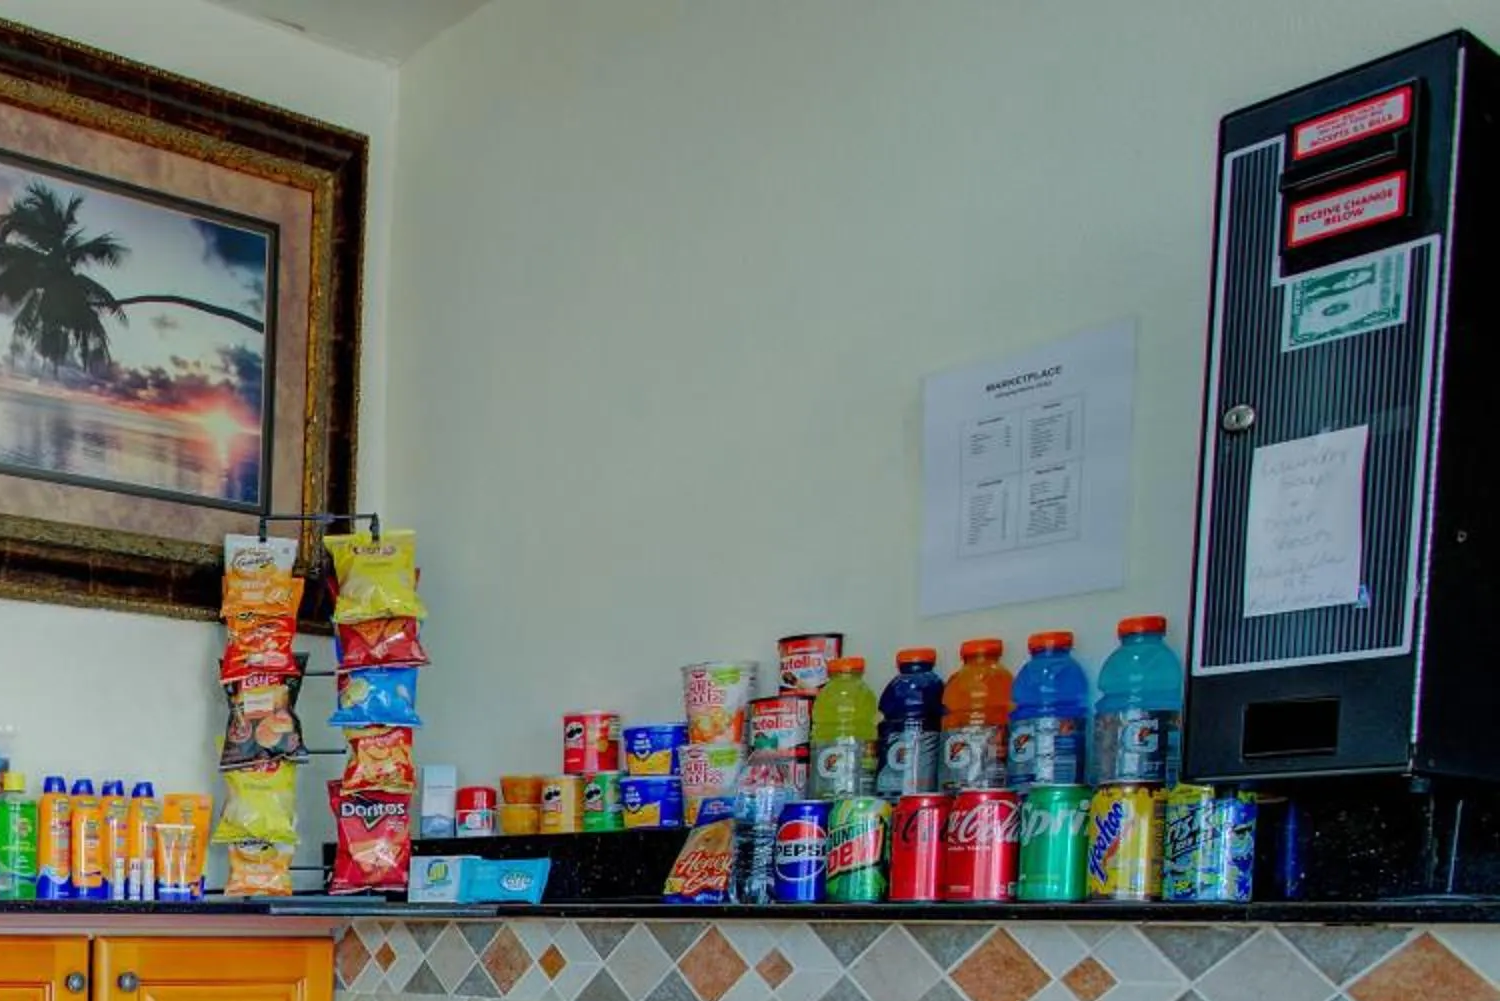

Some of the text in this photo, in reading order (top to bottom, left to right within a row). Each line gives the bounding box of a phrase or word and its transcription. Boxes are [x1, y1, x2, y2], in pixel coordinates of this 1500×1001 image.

[1298, 188, 1393, 224] RECEIVE CHANGE
[1324, 207, 1364, 226] BELOW
[985, 365, 1062, 392] MARKETPLACE
[341, 802, 405, 817] Doritos
[1020, 799, 1090, 846] Spri
